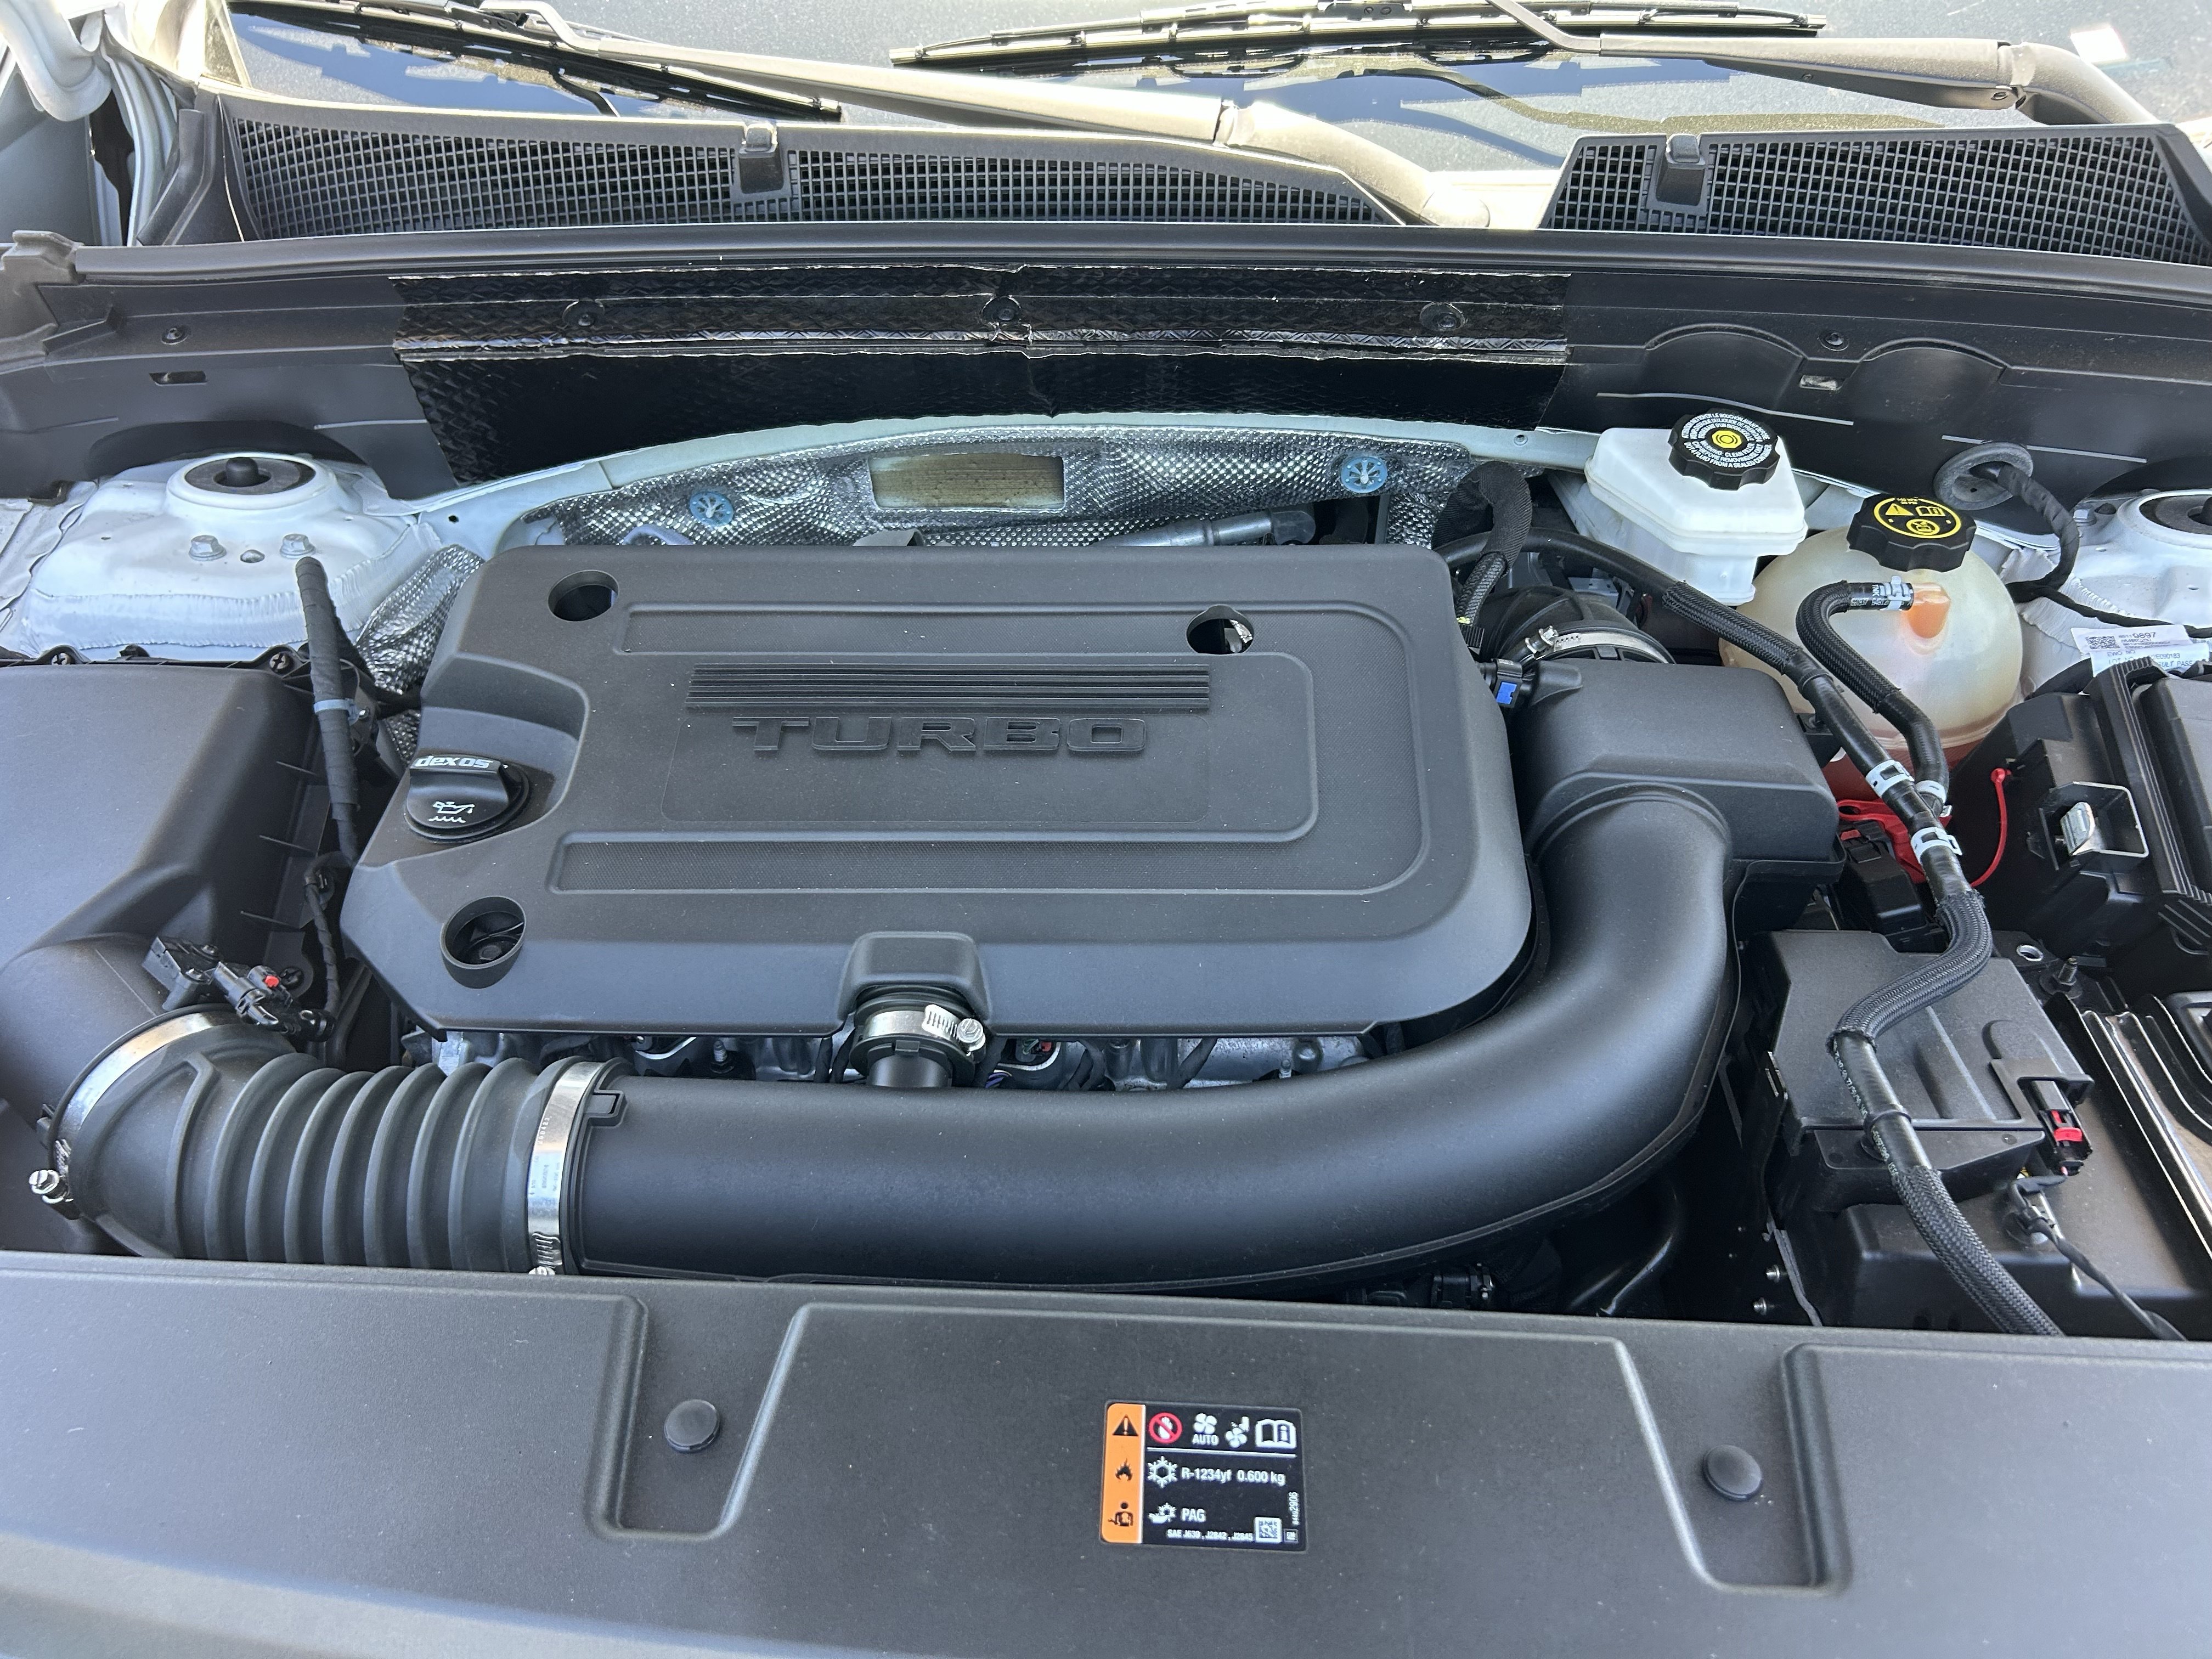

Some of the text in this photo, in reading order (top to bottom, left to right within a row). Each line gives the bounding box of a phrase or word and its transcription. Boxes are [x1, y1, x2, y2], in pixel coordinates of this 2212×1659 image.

[732, 715, 1147, 753] TURBO
[415, 755, 493, 768] dexos
[1192, 1433, 1219, 1446] AUTO
[1181, 1466, 1285, 1486] R-1234yf 0.600 kg
[1181, 1508, 1207, 1523] PAG
[1167, 1529, 1182, 1538] SAE
